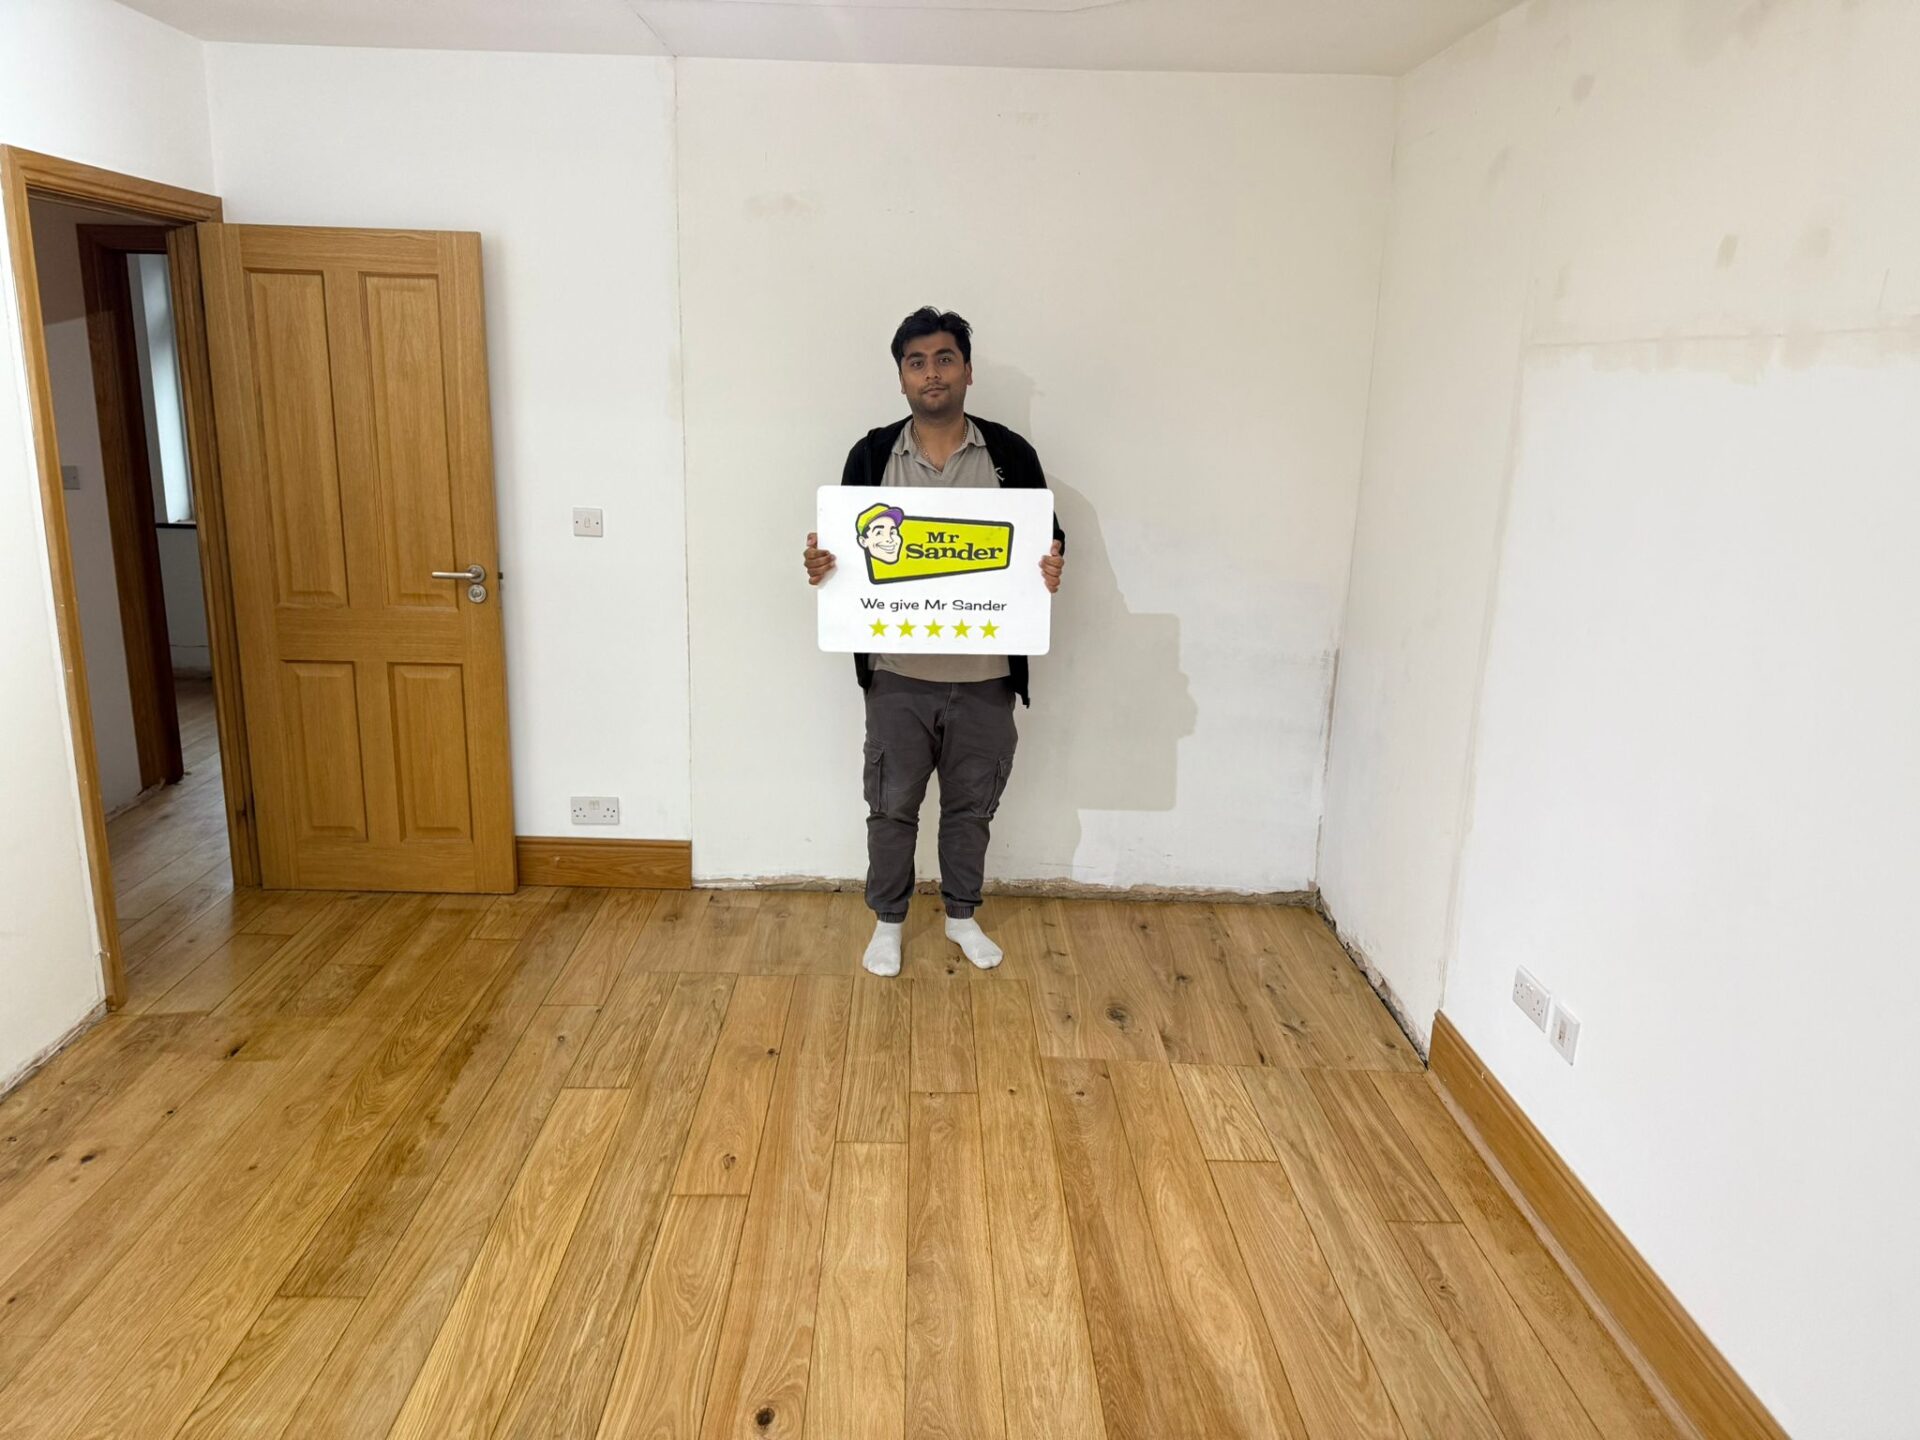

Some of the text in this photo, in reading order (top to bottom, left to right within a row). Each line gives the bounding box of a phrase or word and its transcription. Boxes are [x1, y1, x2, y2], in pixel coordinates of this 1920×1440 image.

[927, 531, 960, 543] Mr
[905, 542, 1003, 561] Sander
[860, 598, 1007, 613] We give Mr Sander
